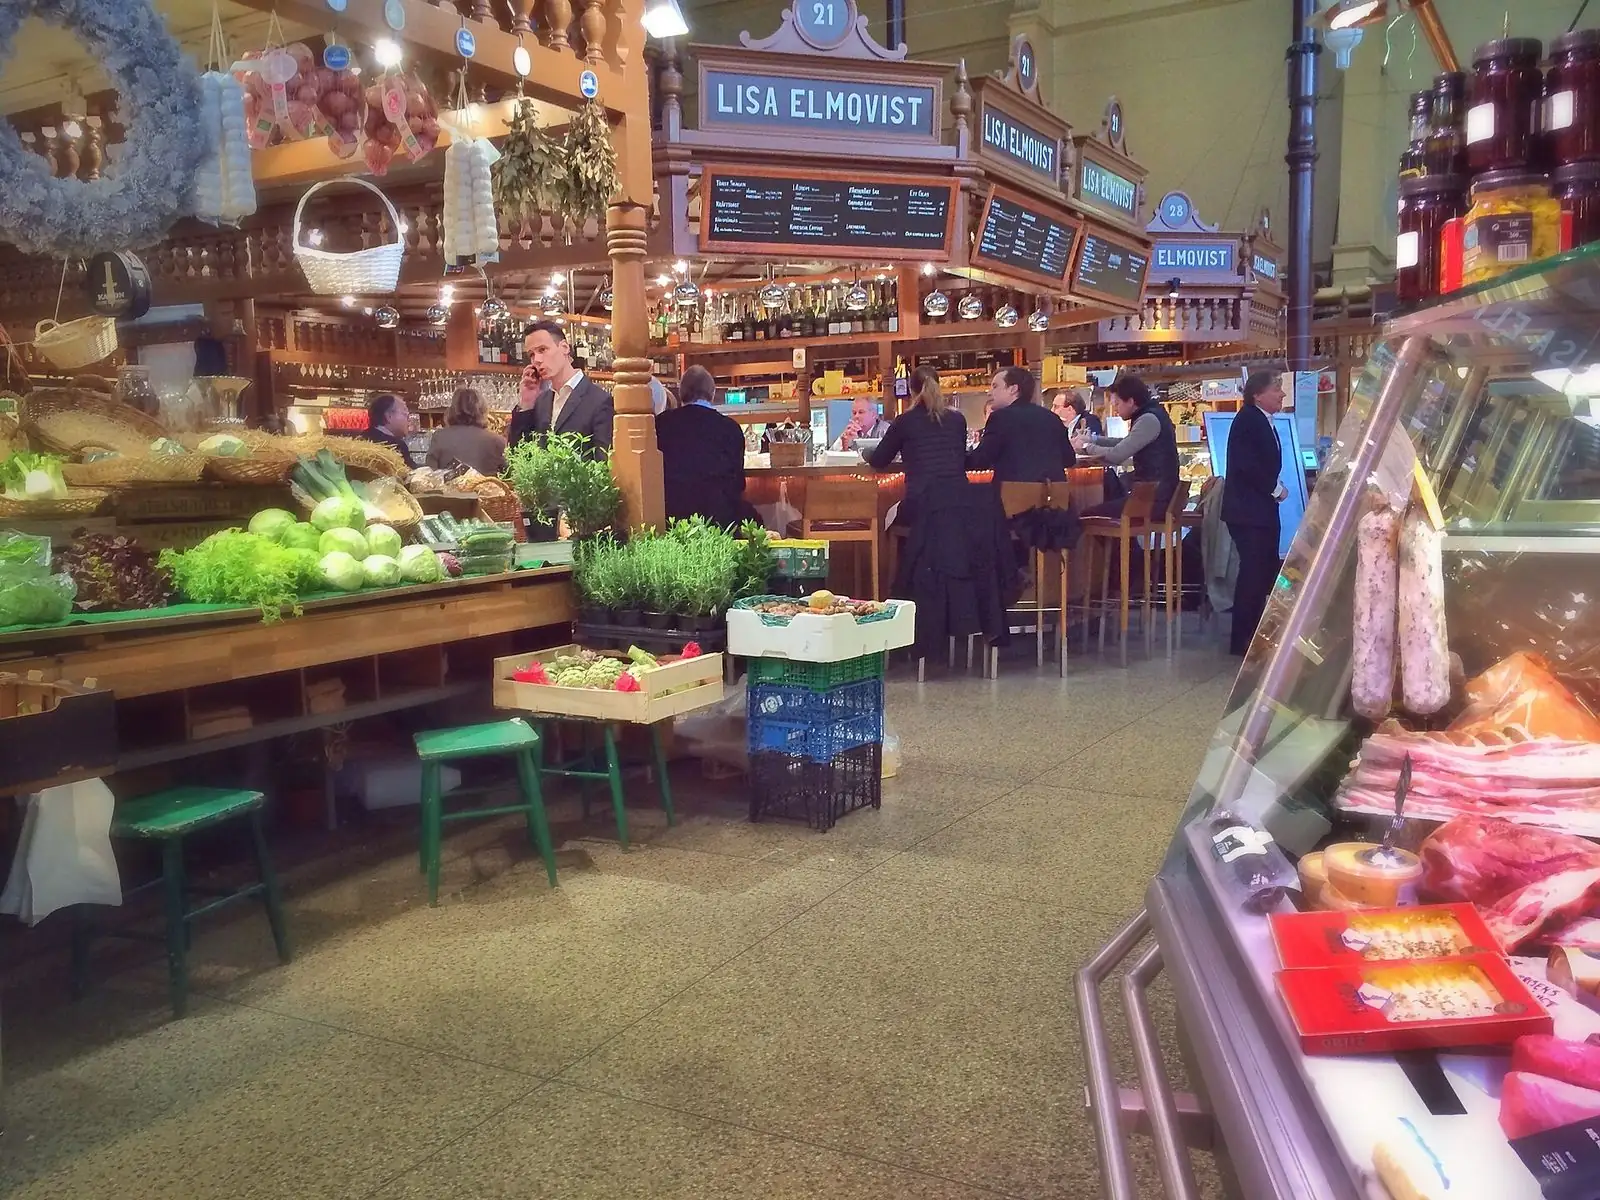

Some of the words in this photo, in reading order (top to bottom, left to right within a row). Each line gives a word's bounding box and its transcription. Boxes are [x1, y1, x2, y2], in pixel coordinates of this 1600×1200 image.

[813, 3, 834, 26] 21
[1021, 55, 1030, 77] 21
[717, 83, 778, 117] LISA
[790, 88, 922, 126] ELMQVIST
[984, 113, 1007, 150] LISA
[1010, 126, 1053, 172] ELMQVIST
[1083, 166, 1100, 195] LISA
[1101, 175, 1134, 211] ELMQVIST
[1169, 205, 1184, 217] 28
[1158, 249, 1227, 267] ELMQVIST
[97, 291, 125, 301] KAON
